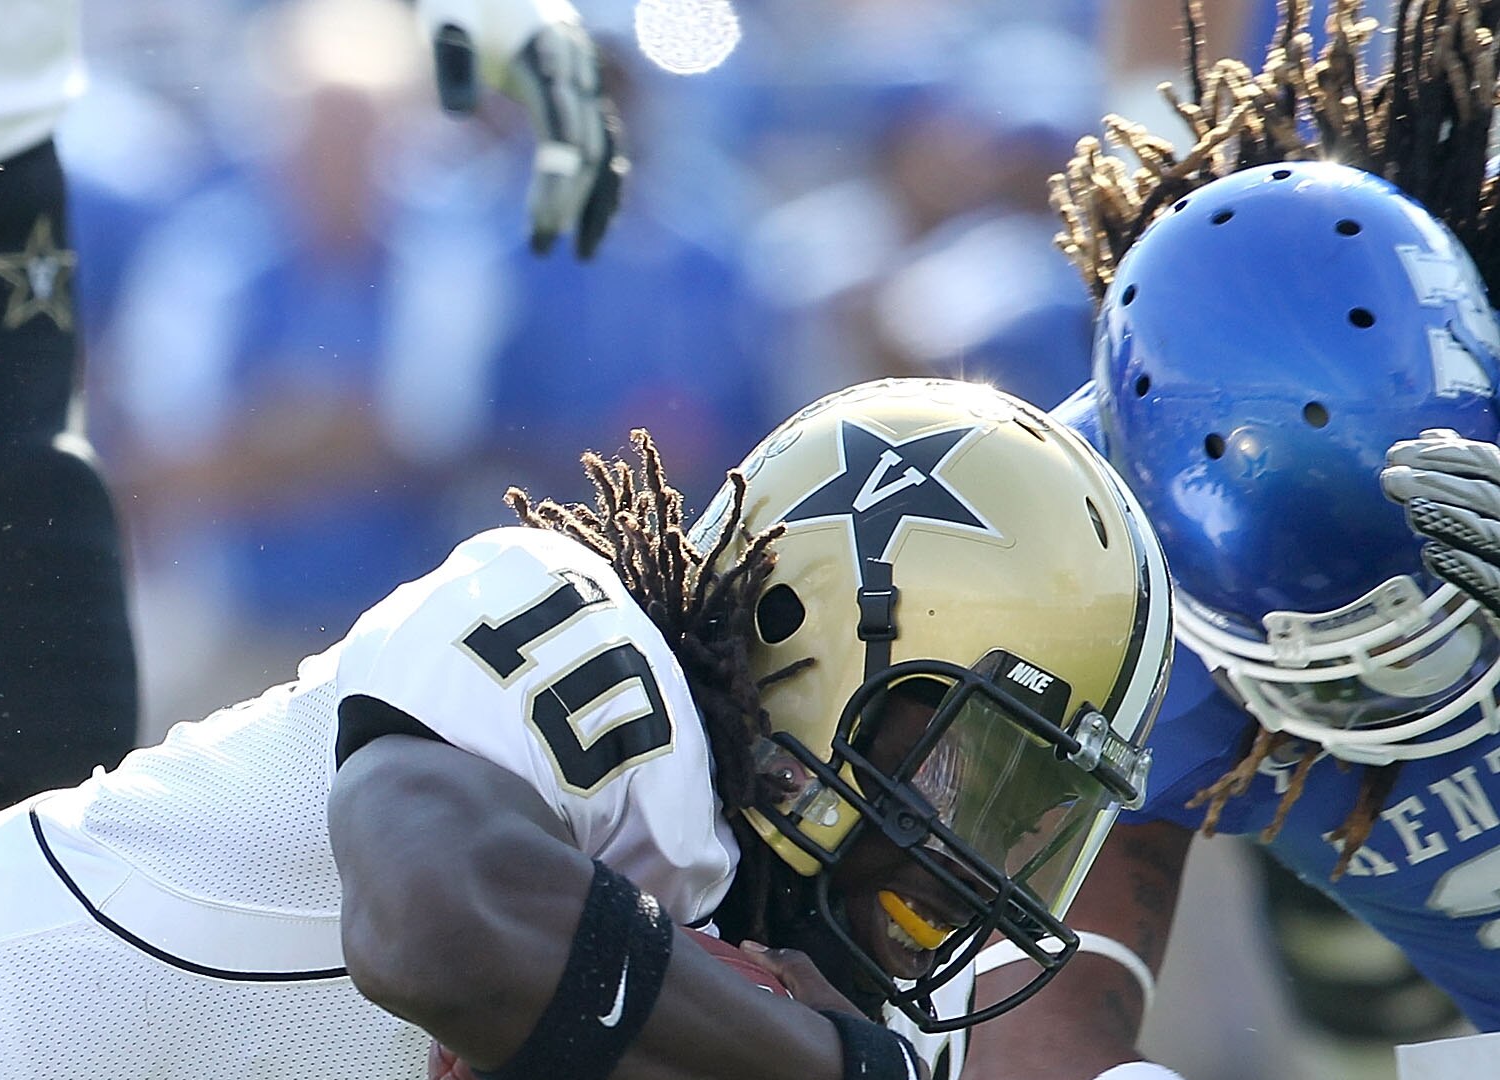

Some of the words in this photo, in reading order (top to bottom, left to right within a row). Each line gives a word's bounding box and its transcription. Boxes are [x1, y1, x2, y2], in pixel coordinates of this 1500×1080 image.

[852, 449, 927, 512] V
[452, 568, 676, 798] 10
[1007, 662, 1054, 695] NIKE
[1321, 746, 1500, 877] KEN
